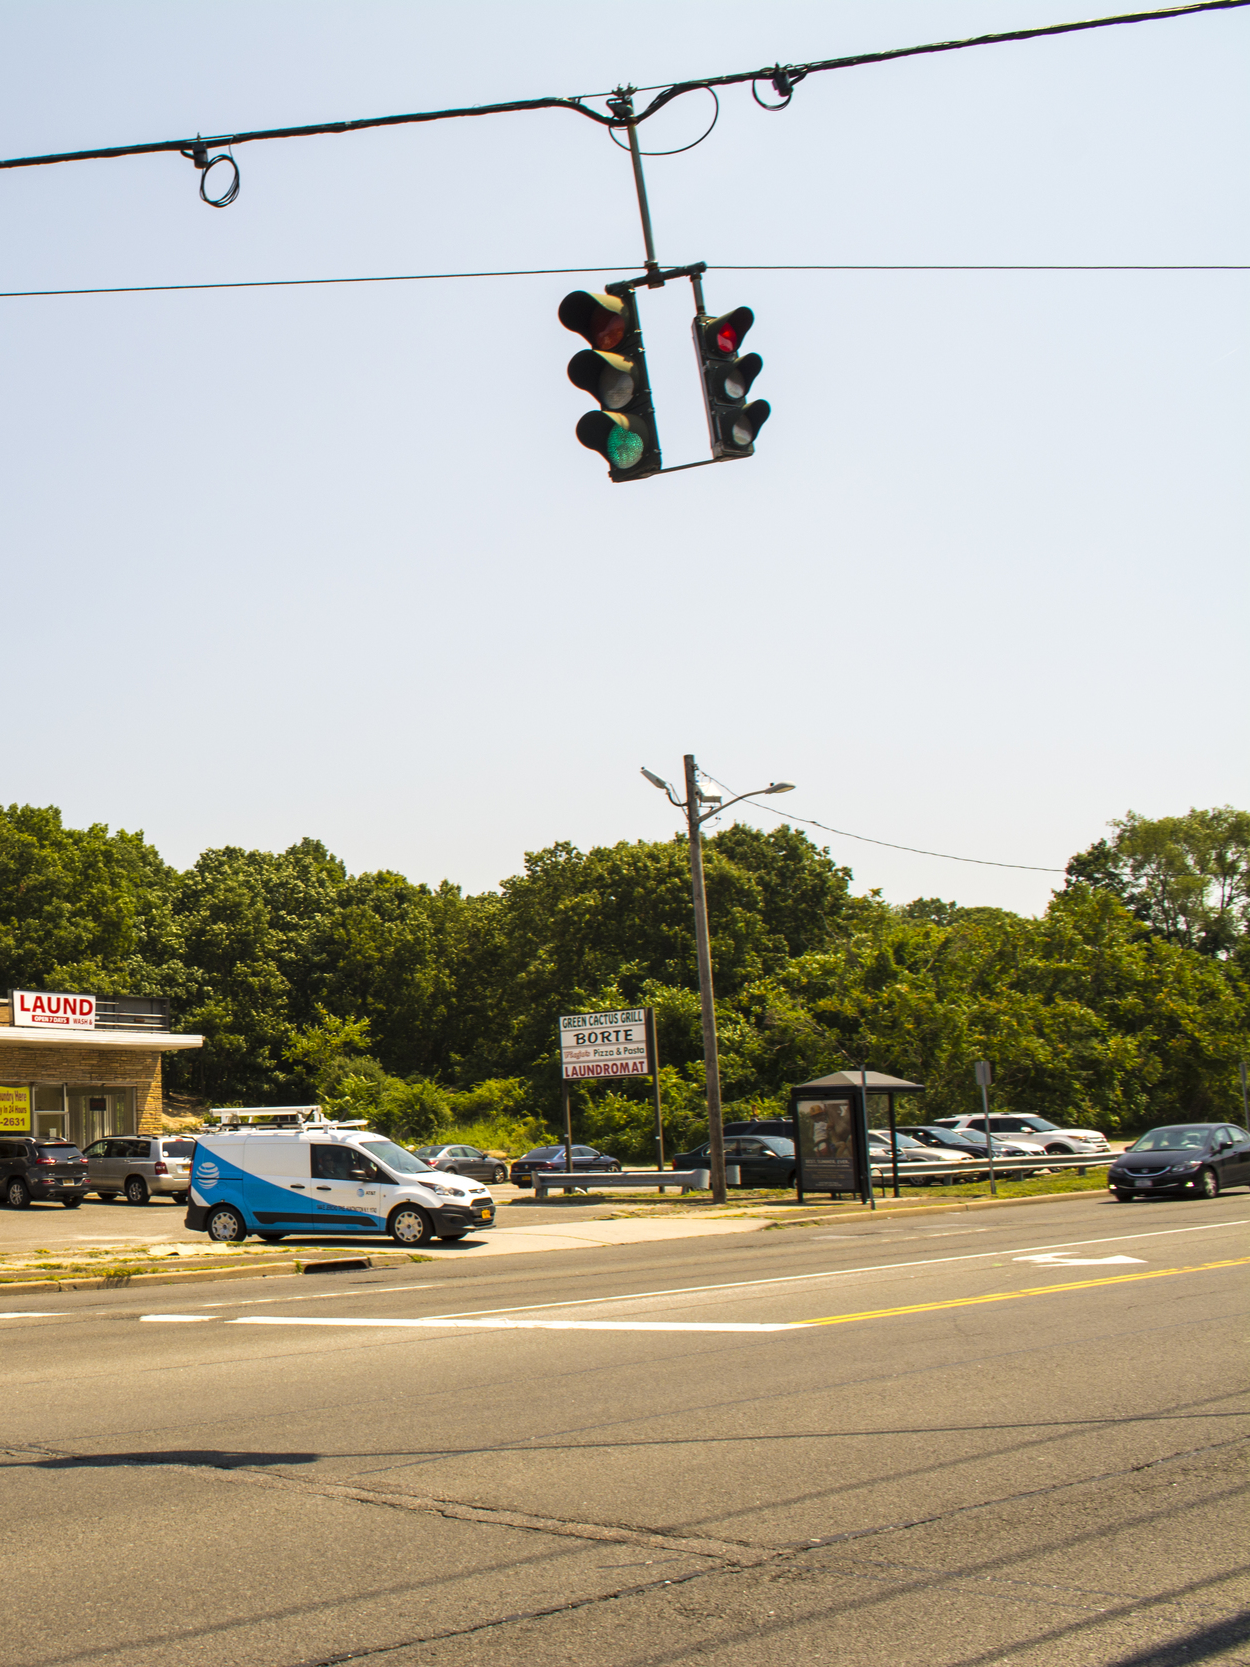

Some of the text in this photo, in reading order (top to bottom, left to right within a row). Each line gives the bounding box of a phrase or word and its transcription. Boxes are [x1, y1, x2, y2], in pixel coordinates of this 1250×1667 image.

[20, 995, 93, 1015] LAUND
[562, 1010, 643, 1029] GREEN CACTUS GRILL
[573, 1029, 633, 1045] BORTE
[593, 1048, 614, 1057] Pizza
[616, 1047, 622, 1055] &
[623, 1046, 645, 1055] Pasta
[564, 1061, 645, 1077] LAUNDROMAT
[14, 1090, 27, 1102] Here
[3, 1105, 8, 1113] In
[9, 1105, 14, 1113] 24
[14, 1105, 27, 1114] Hours
